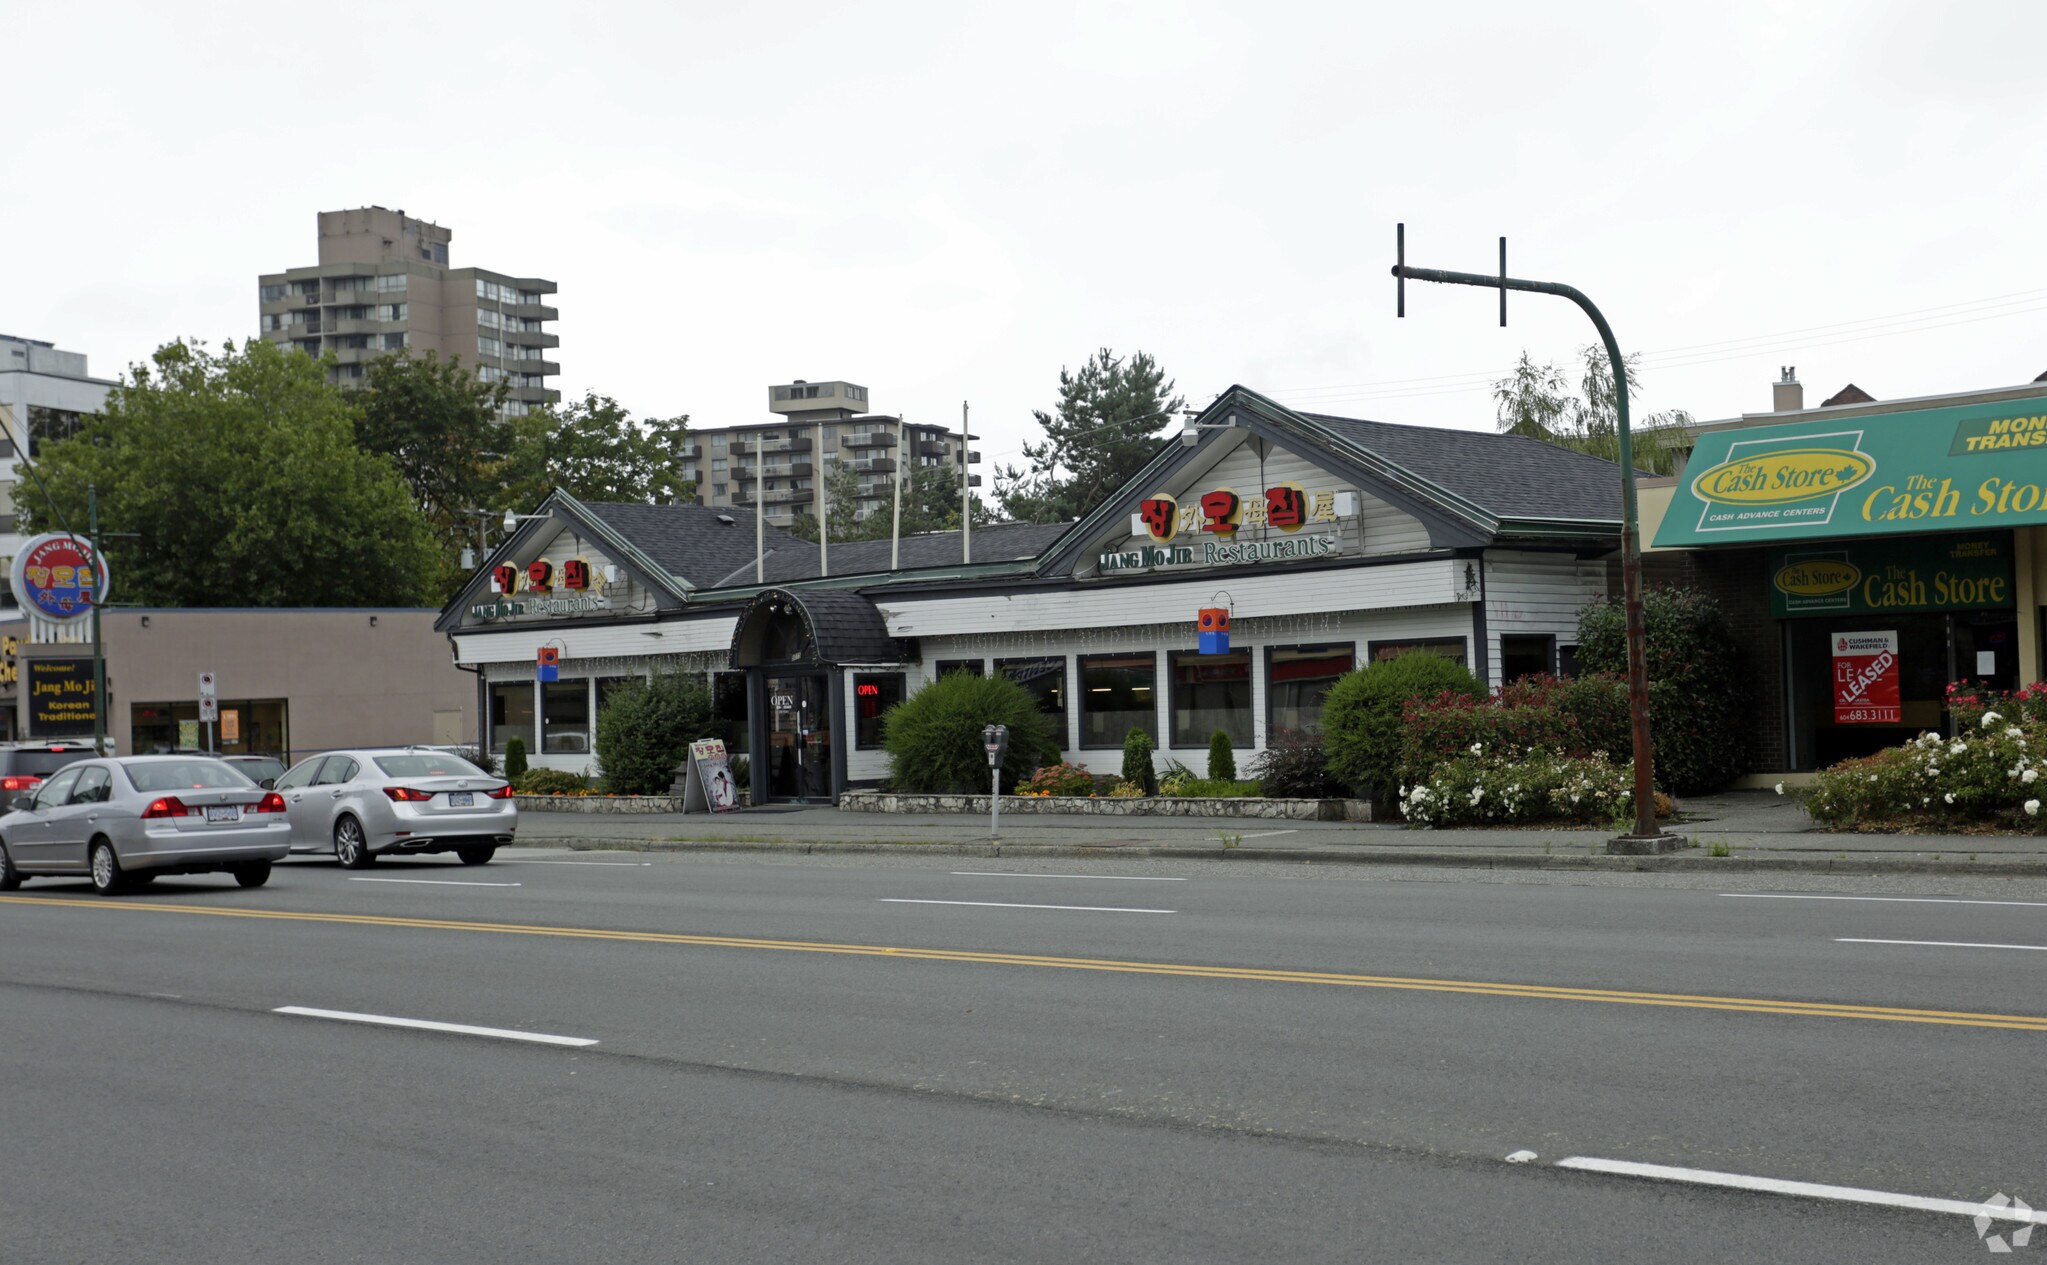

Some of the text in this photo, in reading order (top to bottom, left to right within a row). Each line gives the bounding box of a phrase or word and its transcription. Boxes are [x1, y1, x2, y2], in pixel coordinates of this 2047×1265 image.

[1988, 415, 2047, 434] MON
[1966, 430, 2047, 451] TRANS
[1738, 463, 1757, 475] The
[1713, 466, 1834, 494] Cash Store
[1906, 473, 1938, 491] The
[1862, 477, 1961, 522] Cash
[1709, 507, 1826, 522] CASH ADVANCE CENTERS
[33, 541, 61, 565] JANG
[1099, 549, 1139, 571] JANG
[1141, 545, 1165, 568] MO
[1203, 536, 1329, 564] Restaurants
[1956, 541, 1990, 550] MONEY
[1782, 569, 1841, 587] Cash Store
[1886, 564, 1906, 580] The
[1864, 569, 2005, 608] Cash Store
[528, 597, 599, 615] Restaurants
[1848, 637, 1884, 645] CUSHMAN
[33, 664, 76, 673] Welcome!
[1842, 652, 1893, 703] LEASED
[33, 679, 96, 696] Jang Mo Ji
[857, 684, 878, 696] OPEN
[48, 701, 90, 710] Korean
[771, 695, 794, 706] OPEN
[38, 711, 96, 721] Traditiona
